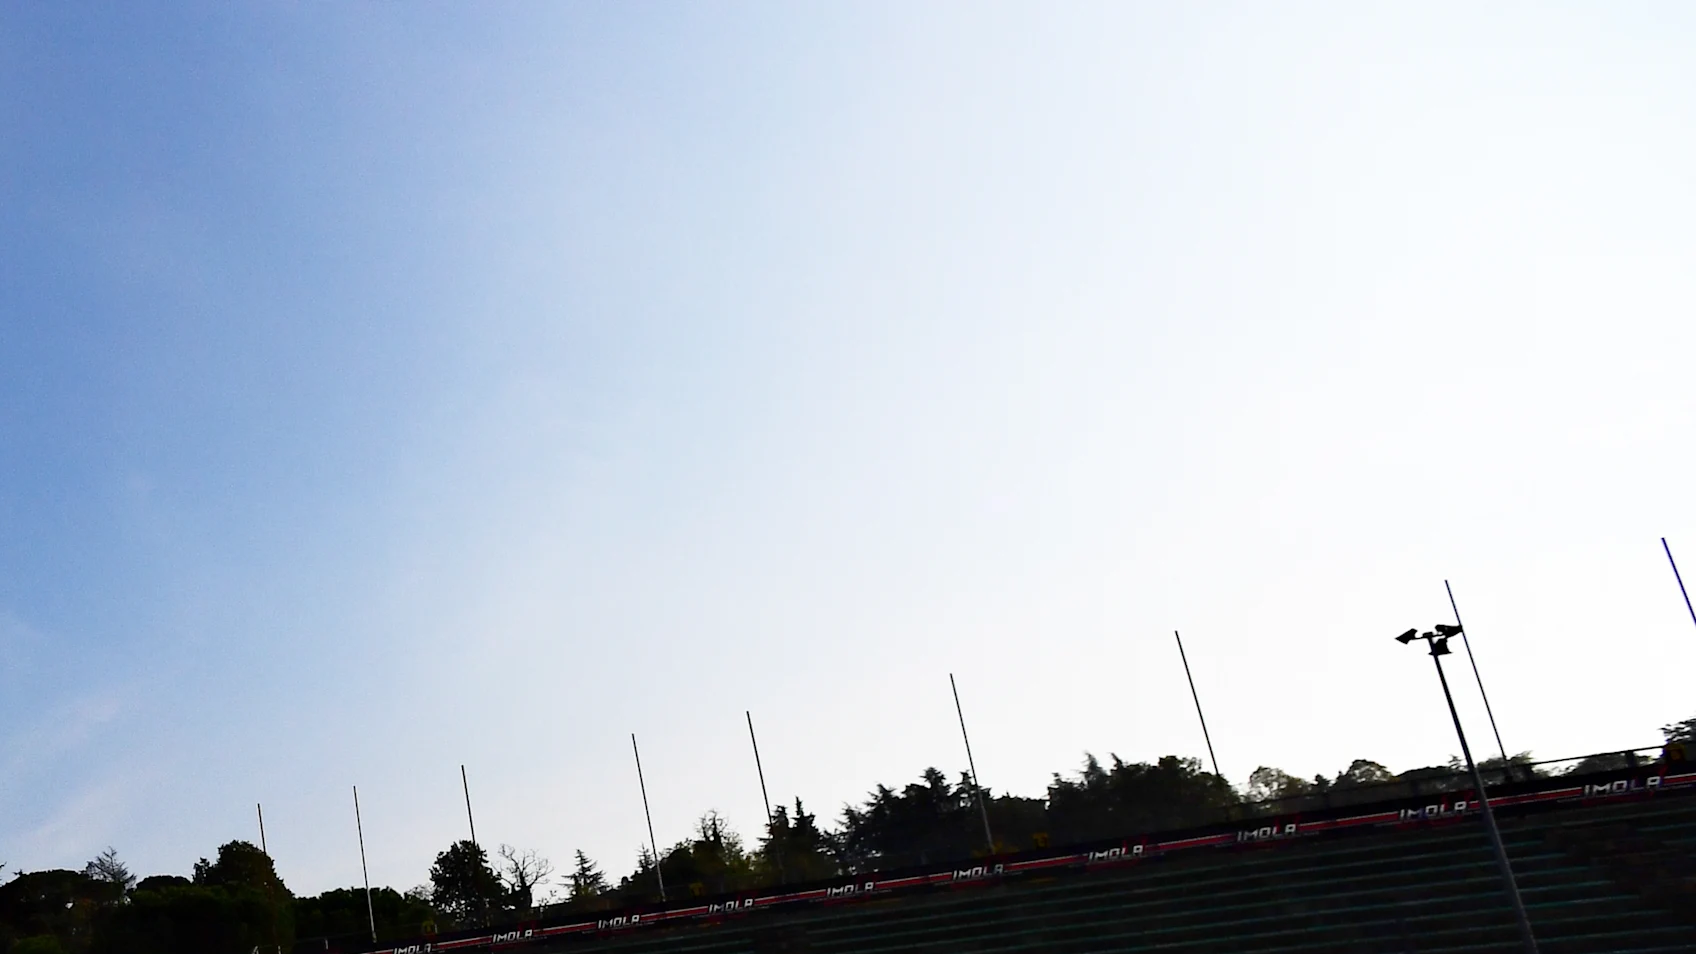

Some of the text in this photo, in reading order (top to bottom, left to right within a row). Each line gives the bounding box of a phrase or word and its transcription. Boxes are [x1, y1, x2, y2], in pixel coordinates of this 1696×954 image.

[1583, 776, 1662, 797] IMOLA
[1399, 800, 1467, 820] IMOLA
[1236, 823, 1297, 842] IMOLA
[1088, 844, 1144, 862] IMOLA
[952, 863, 1004, 881] IMOLA
[825, 881, 875, 898] IMOLA
[708, 898, 754, 913] IMOLA
[597, 914, 640, 929] IMOLA
[492, 929, 533, 943] IMOLA
